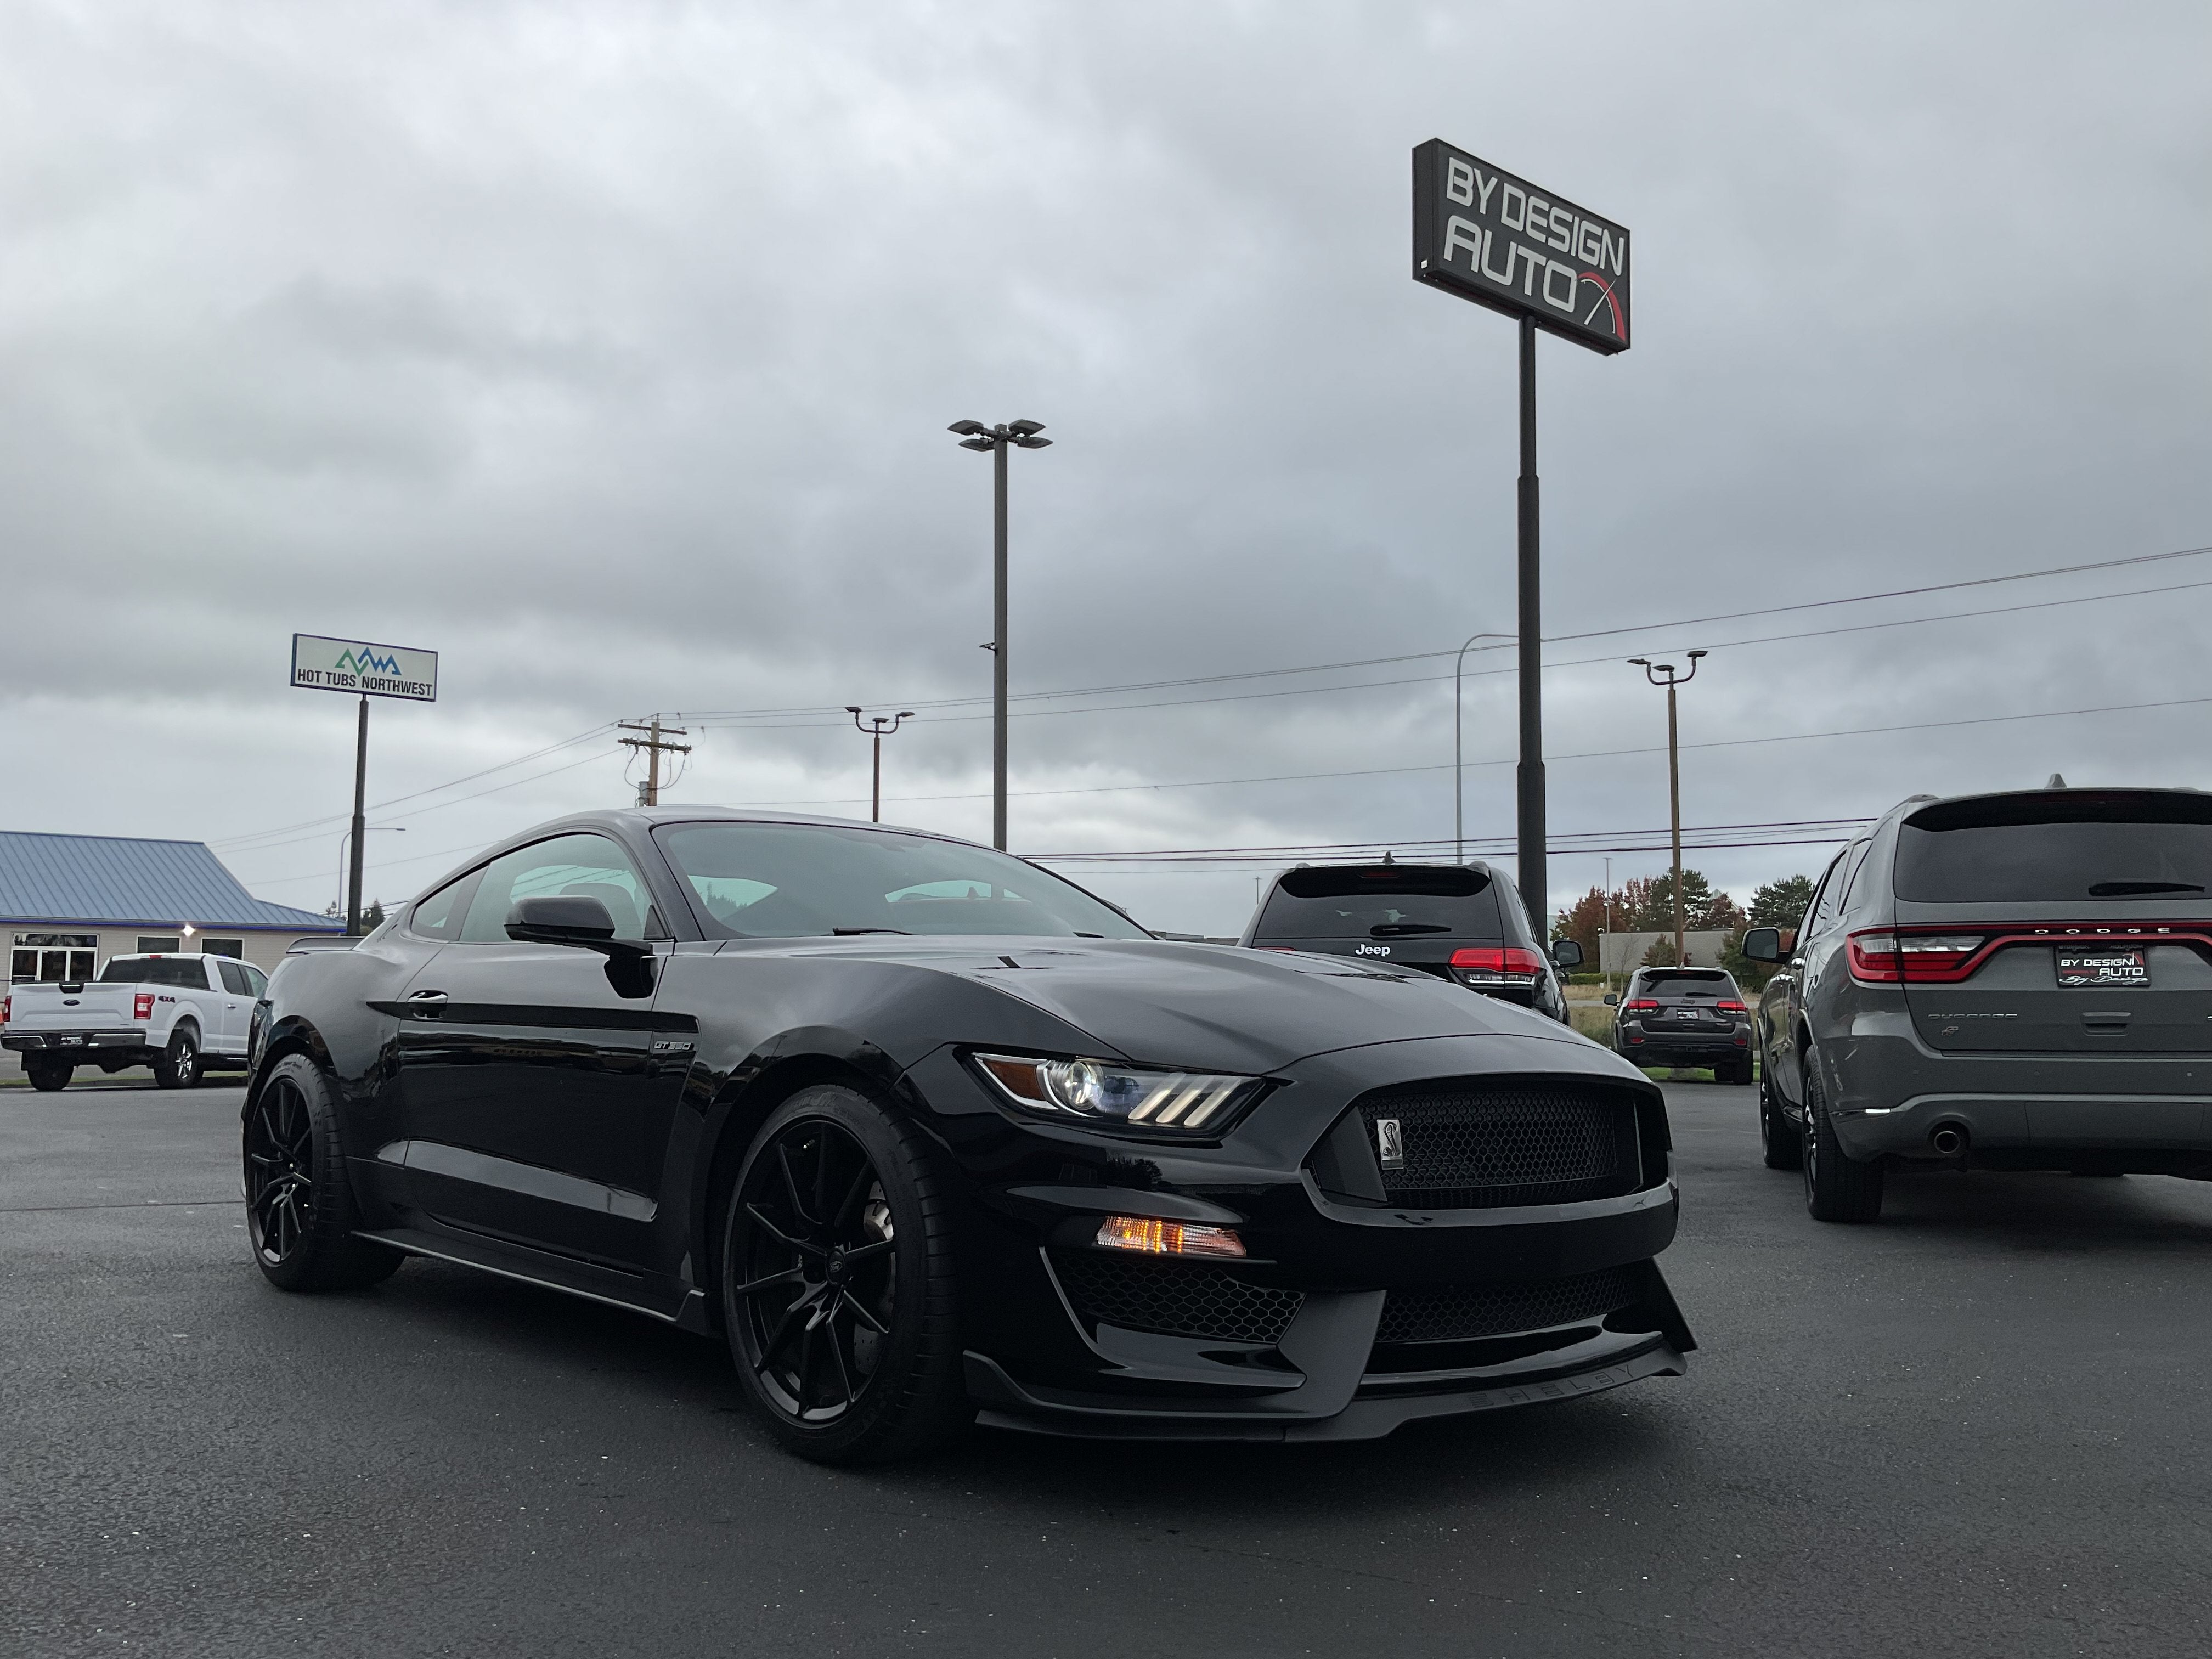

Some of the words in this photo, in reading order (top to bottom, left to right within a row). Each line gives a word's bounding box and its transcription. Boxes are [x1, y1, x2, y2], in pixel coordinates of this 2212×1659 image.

[1447, 157, 1498, 215] BY
[1501, 183, 1624, 276] DESIGN
[1443, 215, 1577, 313] AUTO
[297, 669, 322, 683] HOT
[326, 672, 357, 686] TUBS
[362, 676, 433, 696] NORTHWEST
[1355, 944, 1391, 957] Jeep
[2083, 958, 2132, 967] DESIGN
[2099, 967, 2144, 977] AUTO
[2059, 975, 2089, 985] By
[2090, 975, 2148, 985] Design
[1470, 1364, 1633, 1408] SHELBY
